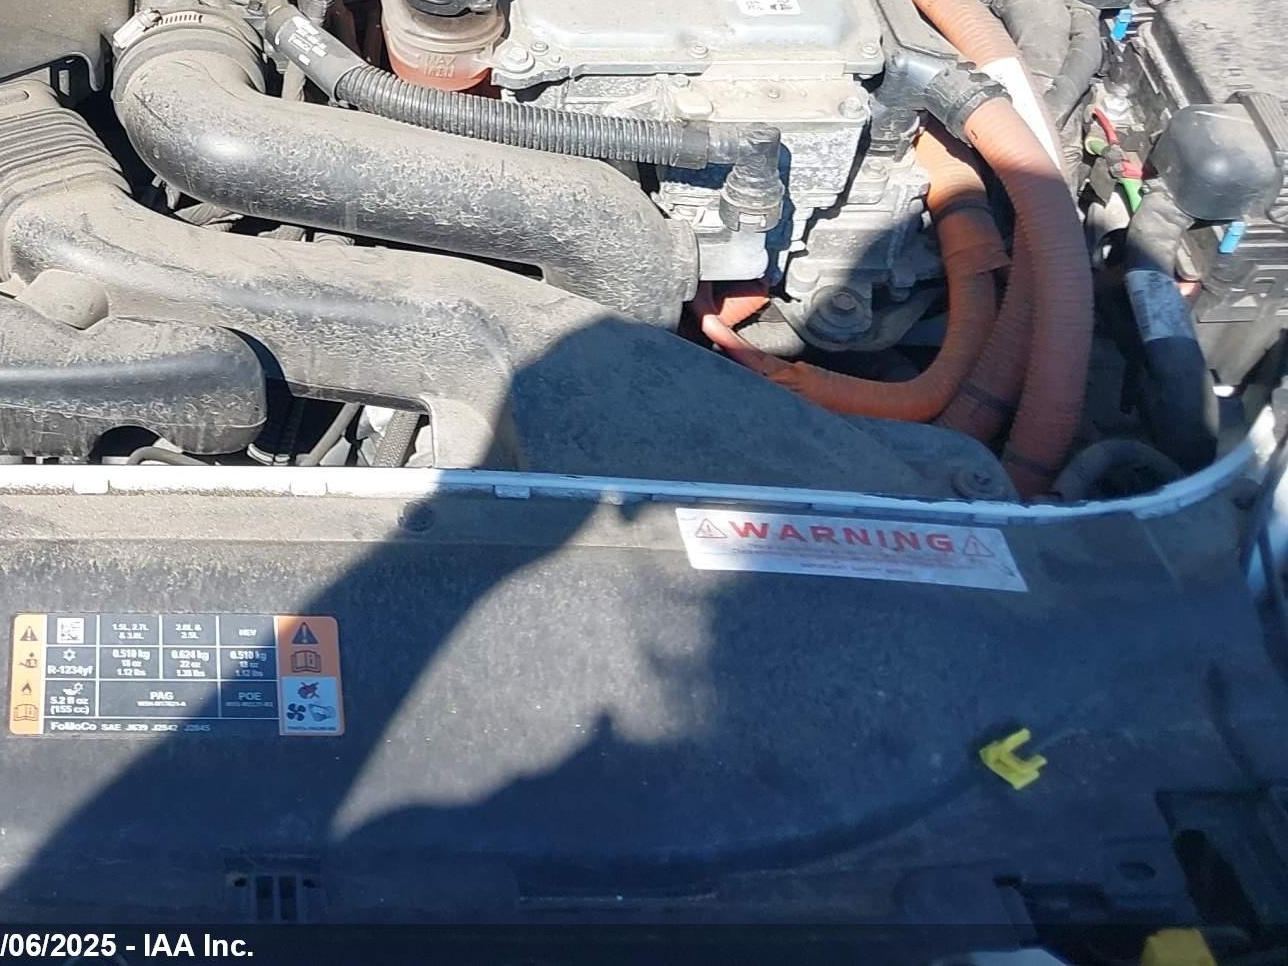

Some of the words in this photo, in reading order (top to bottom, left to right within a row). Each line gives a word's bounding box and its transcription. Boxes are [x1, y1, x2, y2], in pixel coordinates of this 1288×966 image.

[728, 520, 955, 553] WARNING
[47, 665, 93, 677] R-1234yf
[50, 696, 66, 704] 5.2
[149, 690, 174, 701] PAG
[238, 692, 263, 701] POE
[50, 705, 72, 715] (155
[73, 705, 90, 715] cc)
[50, 721, 97, 731] FoMoCo
[101, 723, 122, 731] SAE
